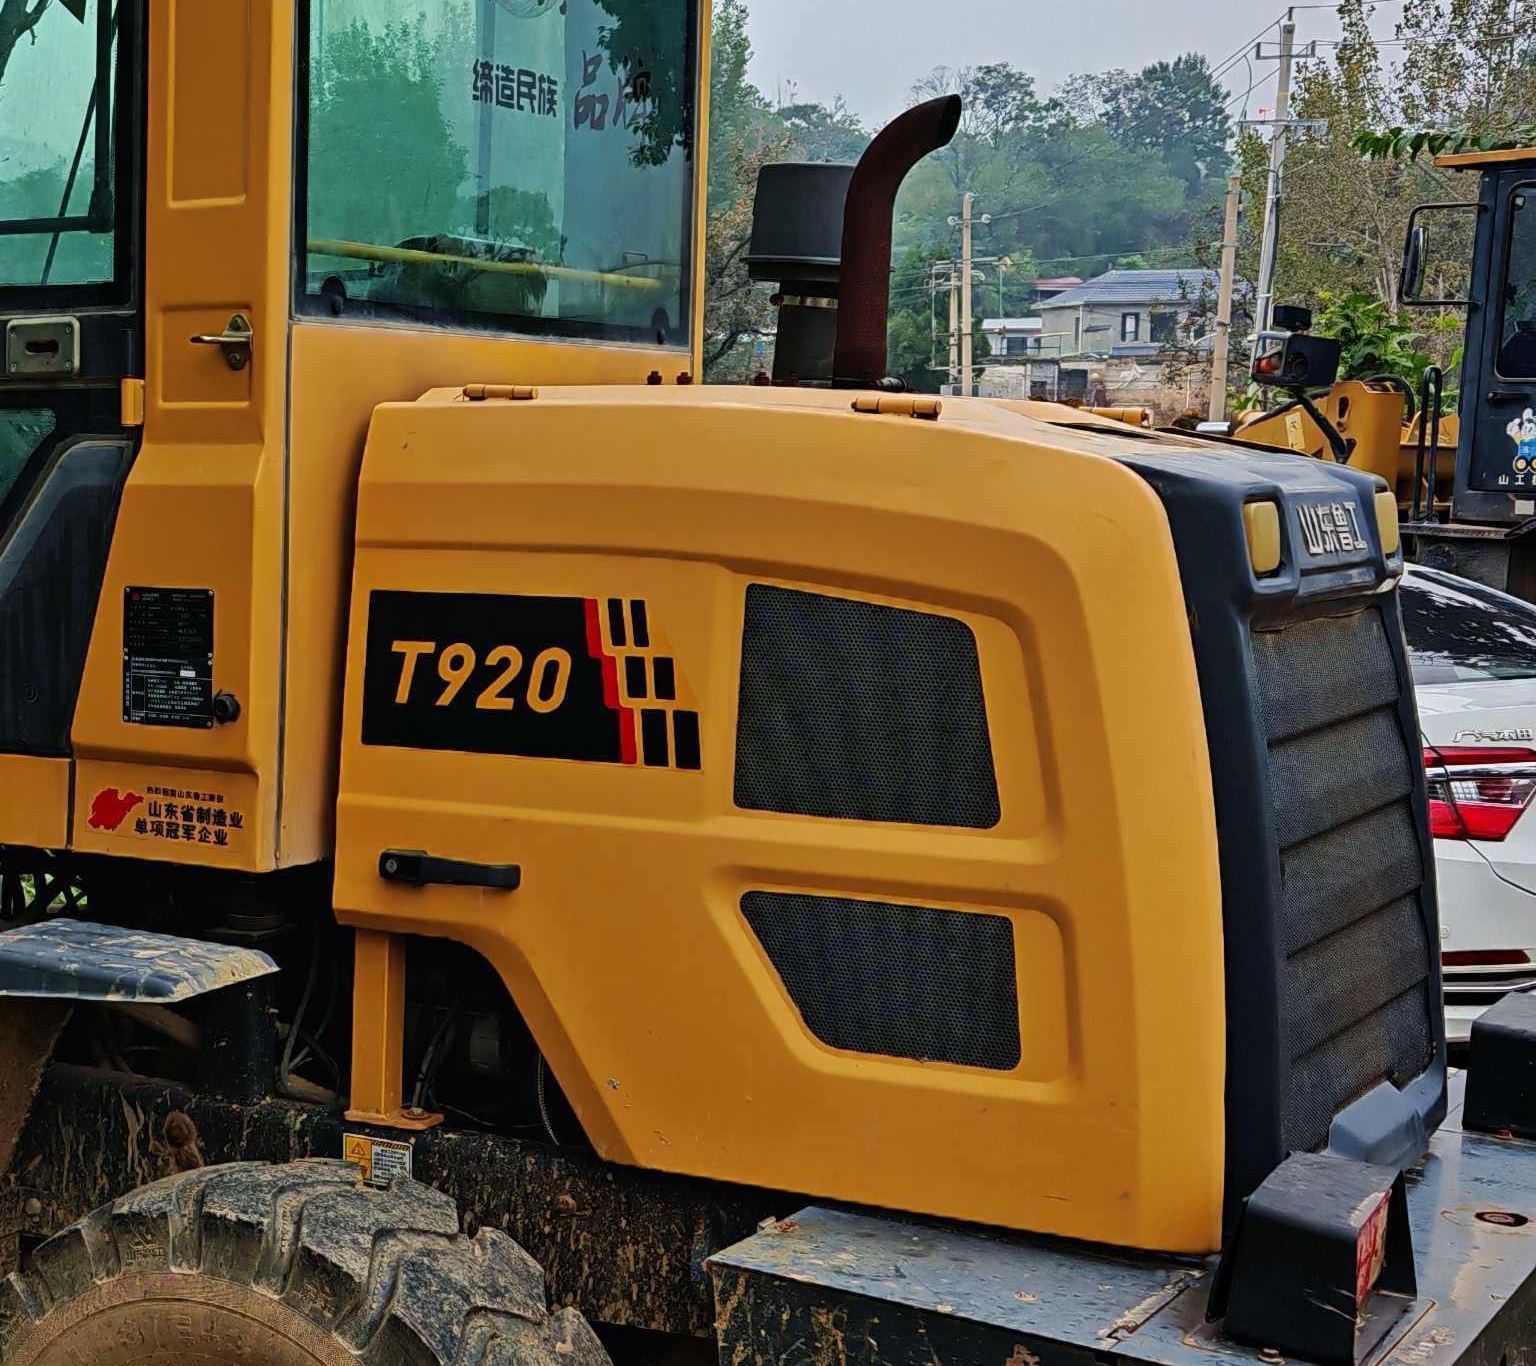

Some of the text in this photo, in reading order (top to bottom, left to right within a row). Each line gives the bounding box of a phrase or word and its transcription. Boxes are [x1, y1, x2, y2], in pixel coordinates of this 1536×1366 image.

[472, 58, 558, 118] 缔造民族
[390, 639, 572, 714] T920
[134, 817, 229, 846] 单项冠军企业
[148, 800, 244, 829] 山东省制造业
